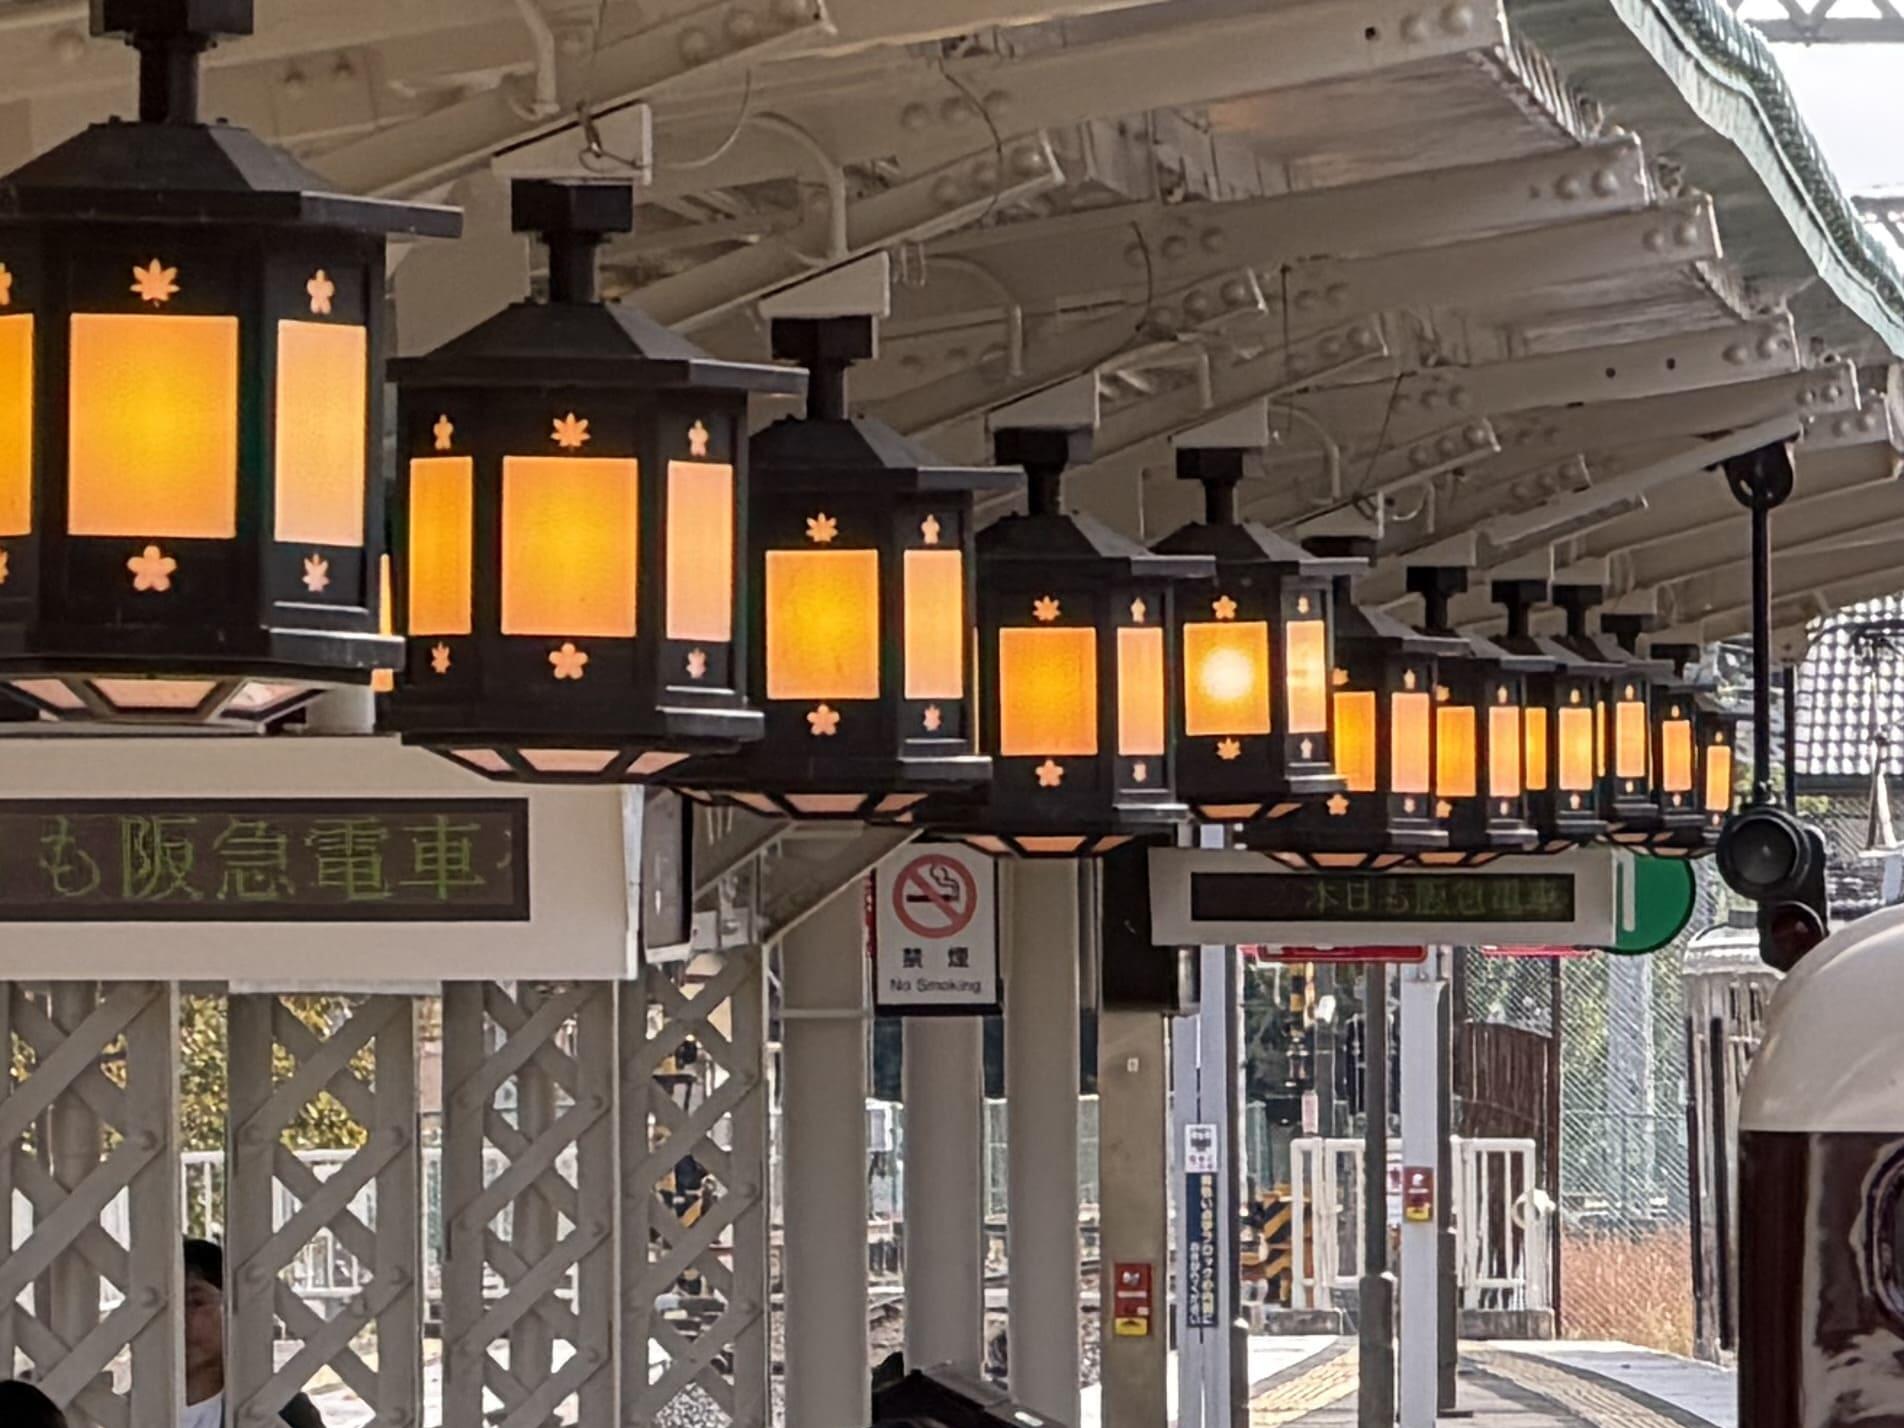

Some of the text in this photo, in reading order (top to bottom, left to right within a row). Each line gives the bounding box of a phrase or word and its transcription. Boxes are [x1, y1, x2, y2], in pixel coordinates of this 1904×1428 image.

[38, 813, 512, 900] も阪急電車
[890, 978, 982, 994] No Smoking
